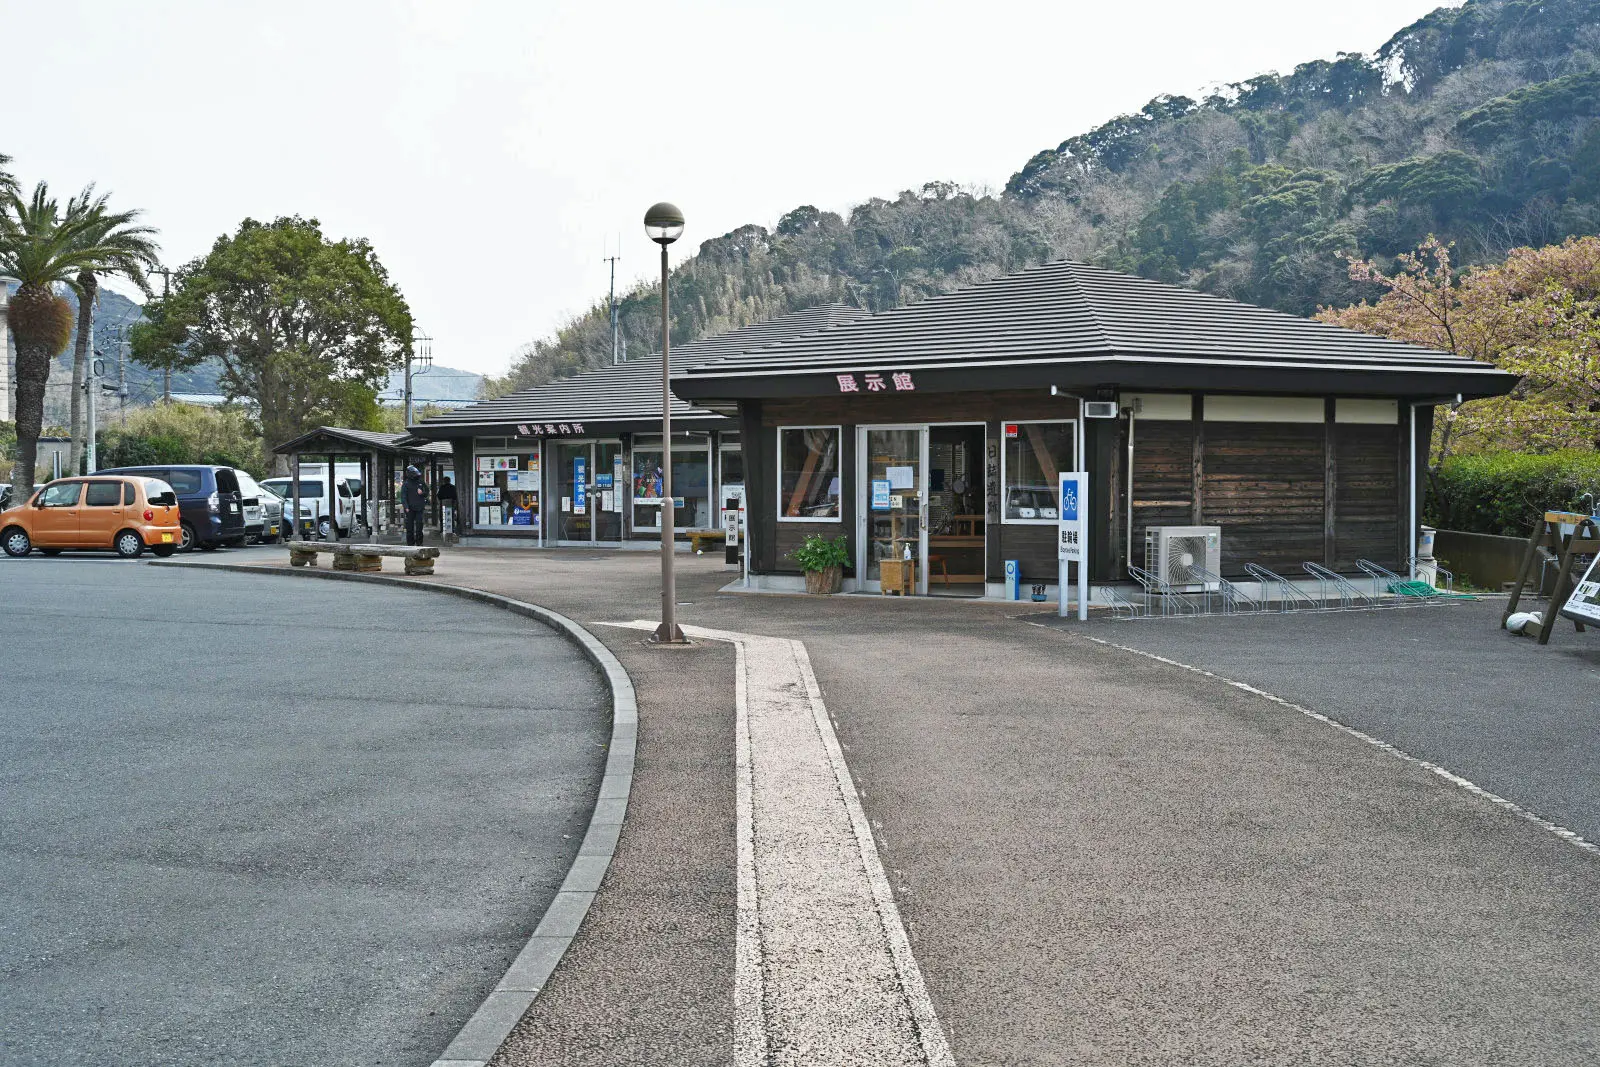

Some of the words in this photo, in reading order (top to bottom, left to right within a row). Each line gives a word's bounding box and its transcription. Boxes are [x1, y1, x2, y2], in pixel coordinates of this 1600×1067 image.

[836, 372, 915, 392] 展示館
[517, 424, 585, 435] 観光案内所
[1061, 530, 1078, 544] 駐輪場
